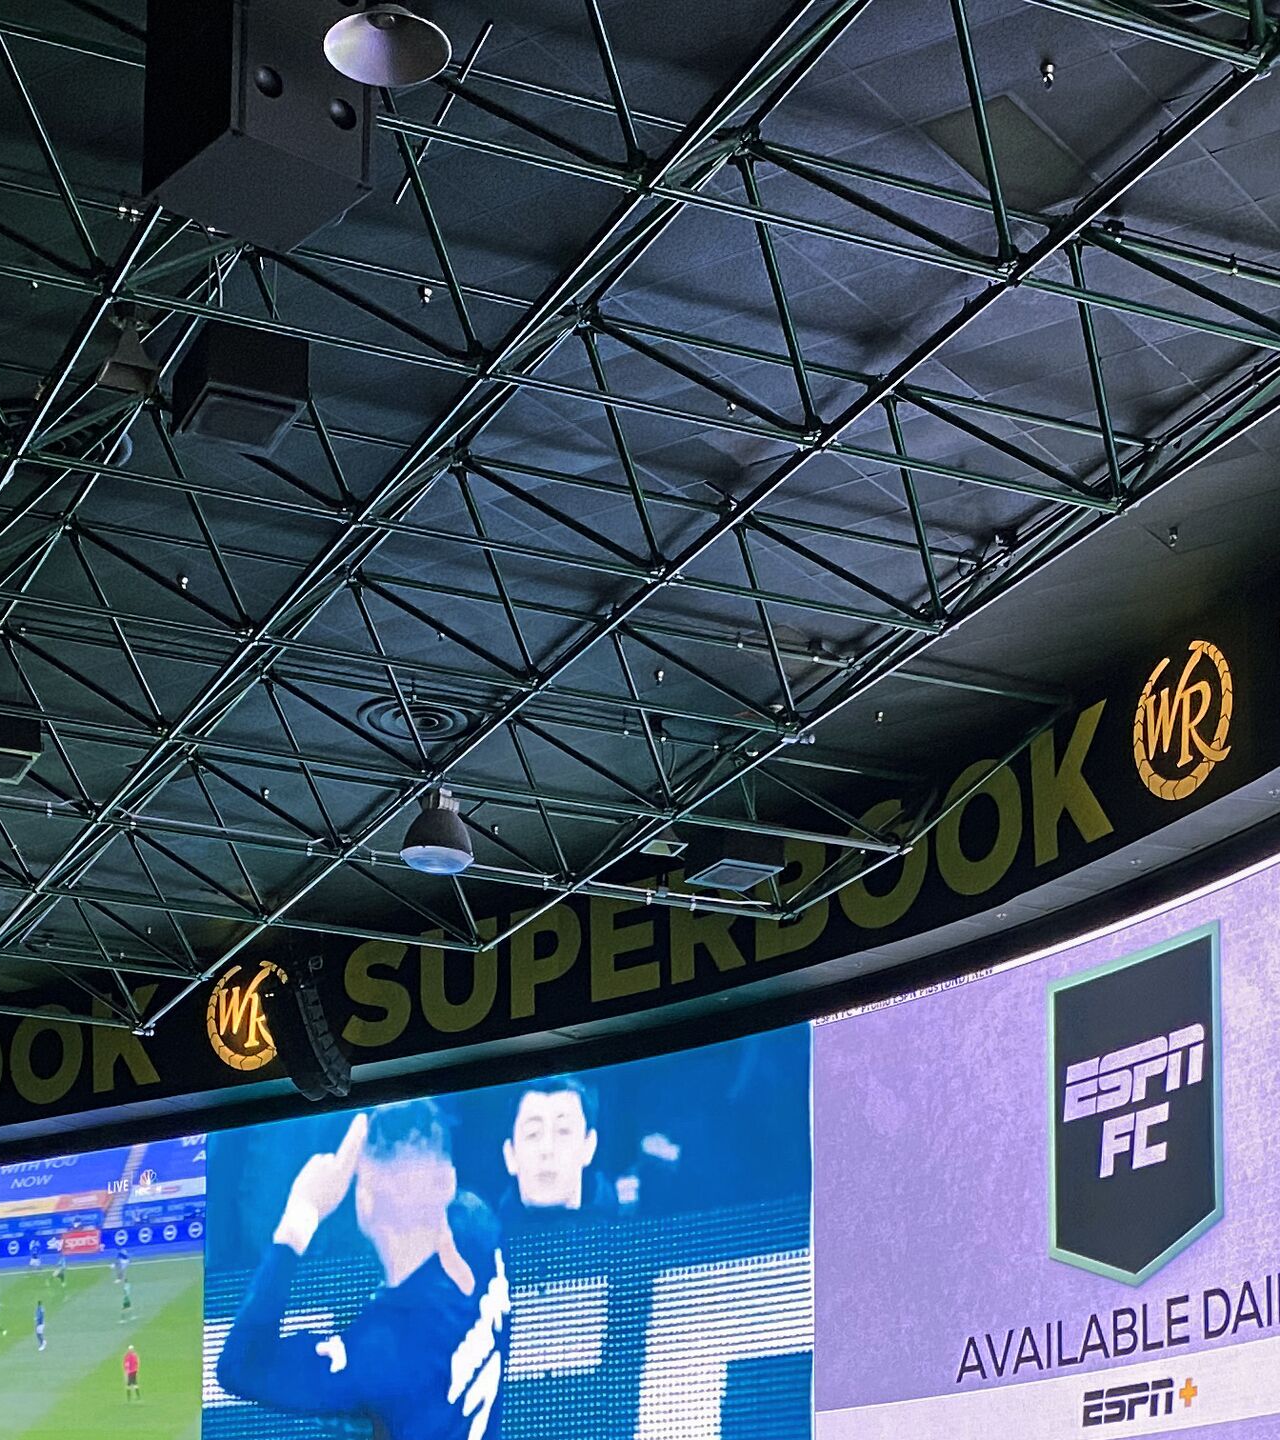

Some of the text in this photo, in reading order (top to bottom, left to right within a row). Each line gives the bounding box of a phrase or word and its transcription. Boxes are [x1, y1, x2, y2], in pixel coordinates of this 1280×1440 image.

[341, 699, 1115, 1048] SUPERBOOK
[1064, 1023, 1205, 1122] ESPN
[11, 1174, 53, 1189] NOW
[1100, 1101, 1169, 1179] FC
[108, 1180, 129, 1194] LIVE
[956, 1294, 1189, 1384] AVAILABLE
